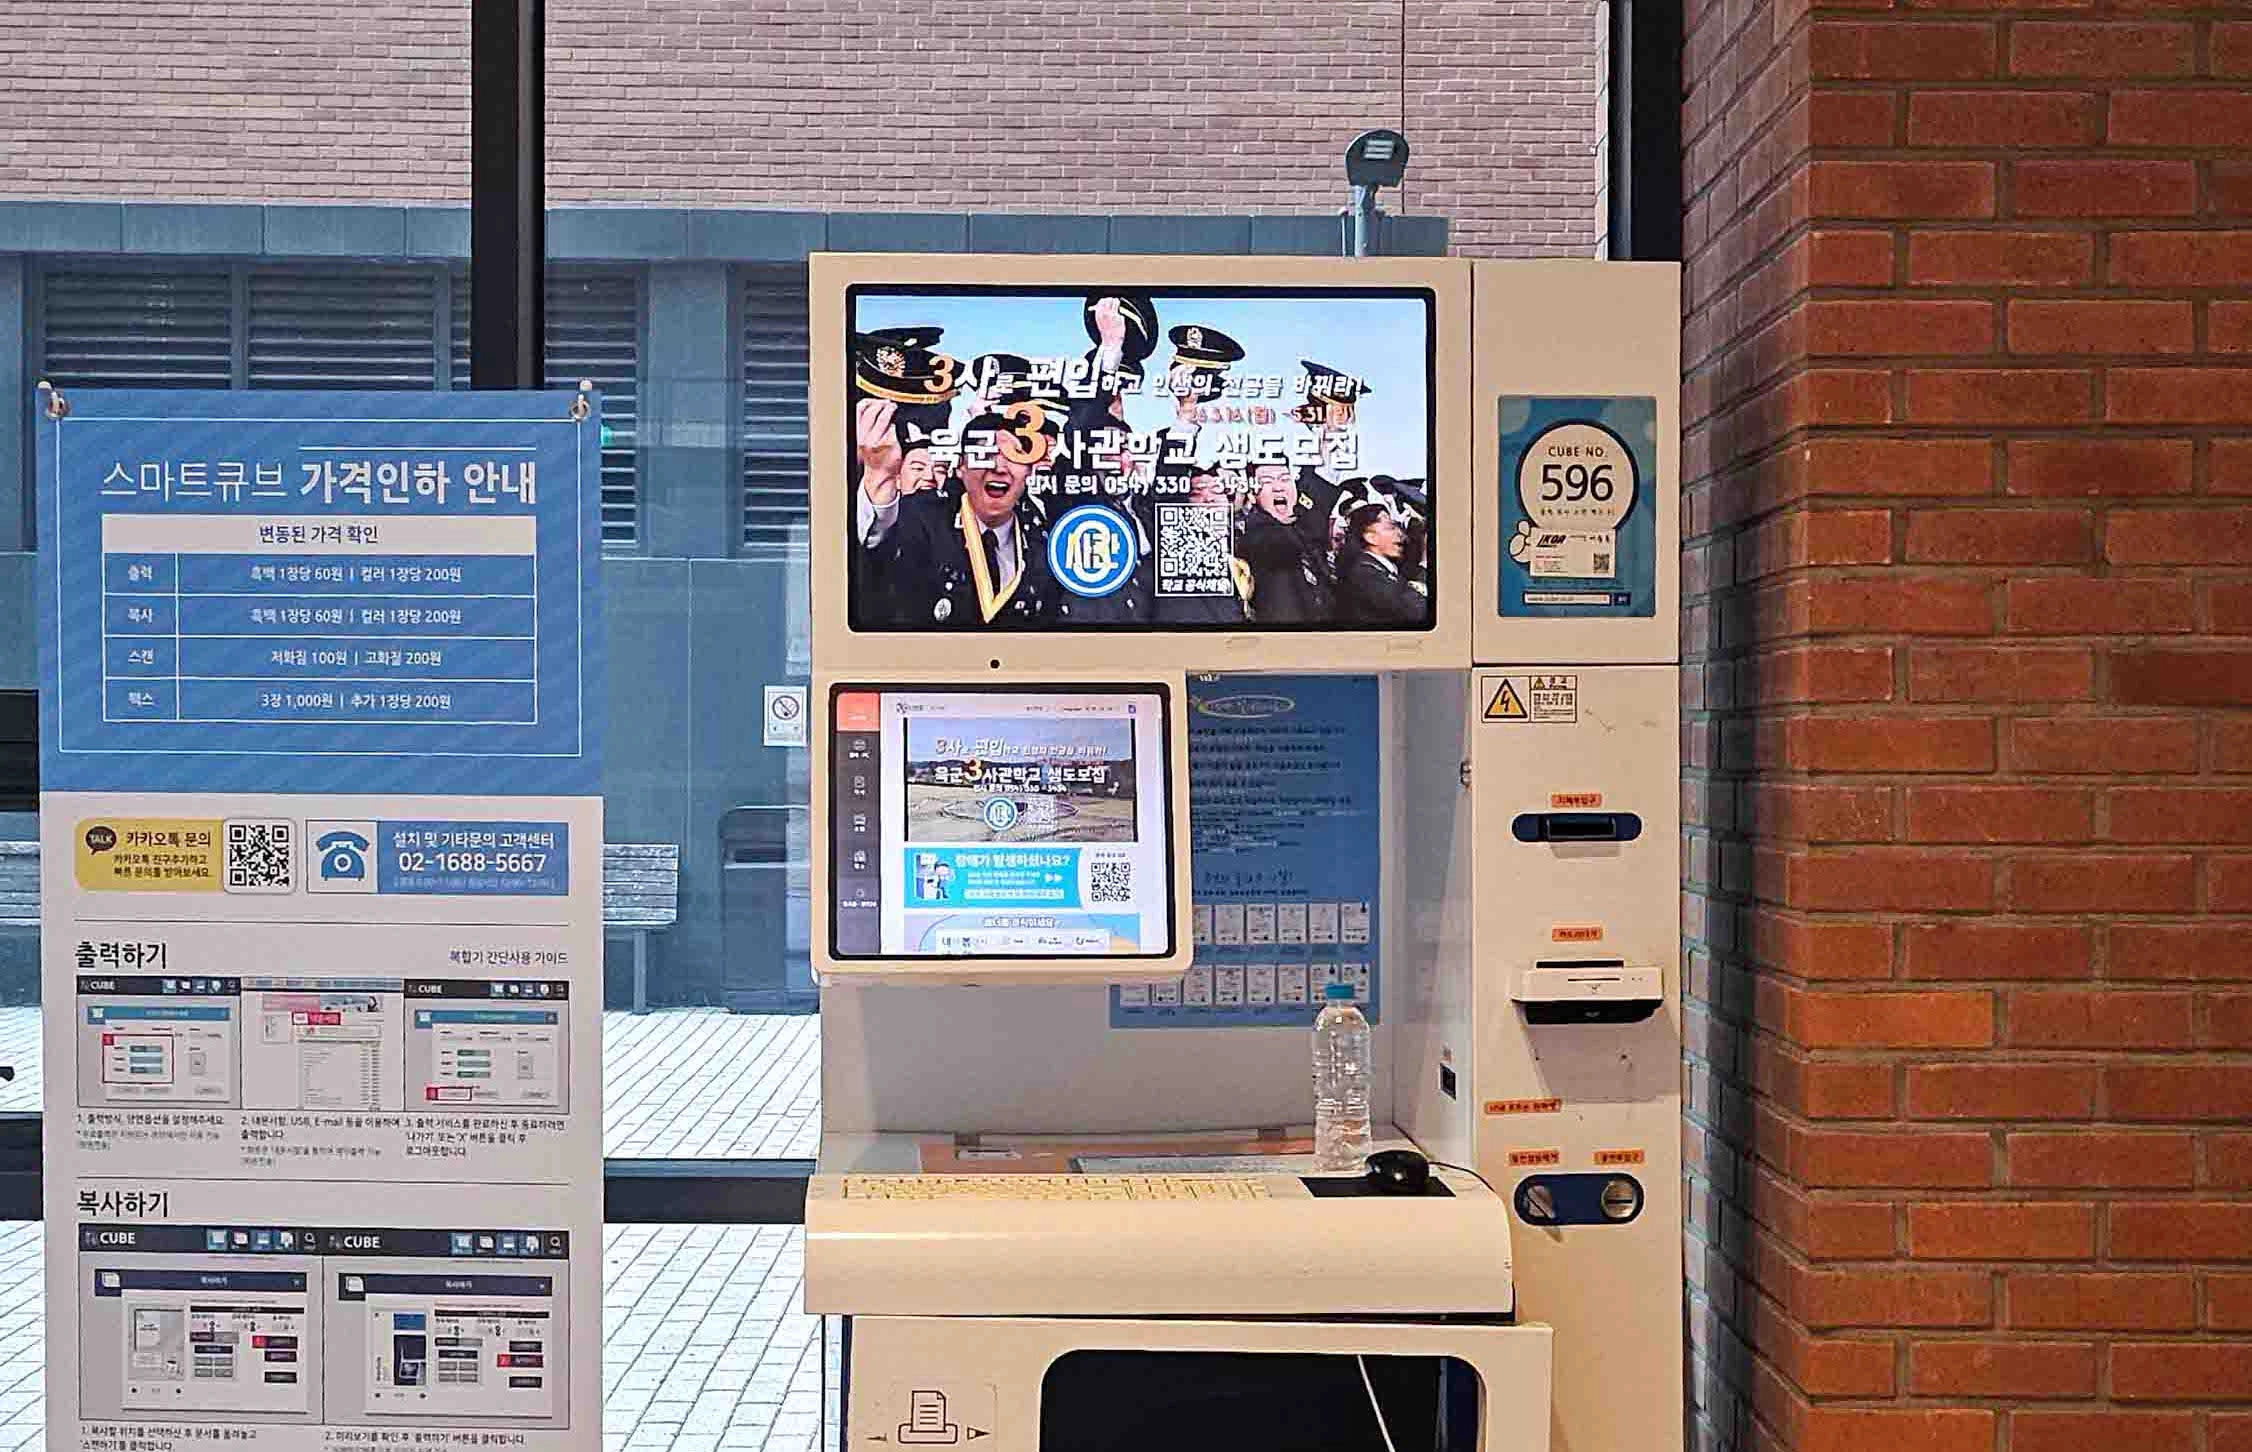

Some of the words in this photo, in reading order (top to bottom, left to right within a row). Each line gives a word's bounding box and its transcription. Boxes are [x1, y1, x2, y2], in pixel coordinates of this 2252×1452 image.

[1217, 431, 1358, 470] 생도모집
[1548, 446, 1579, 457] CUBE
[1585, 447, 1606, 458] NO.
[101, 460, 288, 503] 스마트큐브
[299, 460, 447, 504] 가격인하
[463, 460, 537, 505] 안내
[1064, 475, 1098, 494] 문의
[1155, 475, 1191, 493] 330
[1541, 464, 1614, 501] 596
[259, 525, 306, 545] 변동된
[311, 525, 342, 545] 가격
[347, 525, 379, 545] 확인
[280, 566, 311, 582] 1장당
[315, 567, 343, 582] 60원
[361, 567, 385, 583] 컬러
[390, 567, 421, 582] 1장당
[425, 567, 461, 583] 200원
[281, 608, 311, 624] 1장당
[315, 608, 343, 624] 60원
[362, 608, 385, 625] 컬러
[391, 609, 421, 624] 1장당
[425, 609, 462, 625] 200원
[312, 650, 347, 666] 100원
[406, 651, 441, 667] 200원
[261, 693, 282, 708] 3장
[286, 694, 333, 709] 1,000원
[351, 694, 376, 708] 추가
[380, 694, 411, 709] 1장당
[415, 694, 450, 709] 200원
[126, 831, 180, 847] 카카오톡
[184, 832, 211, 847] 문의
[393, 832, 420, 849] 설치
[424, 832, 438, 848] 및
[442, 832, 496, 849] 기타문의
[502, 833, 554, 849] 고객센터
[399, 852, 547, 873] 02-1688-5667
[74, 942, 167, 970] 출력하기
[486, 950, 532, 966] 간단사용
[534, 951, 570, 966] 가이드
[418, 984, 443, 994] CUBE
[77, 1190, 169, 1217] 복사하기
[100, 1231, 136, 1245] CUBE
[344, 1235, 381, 1249] CUBE
